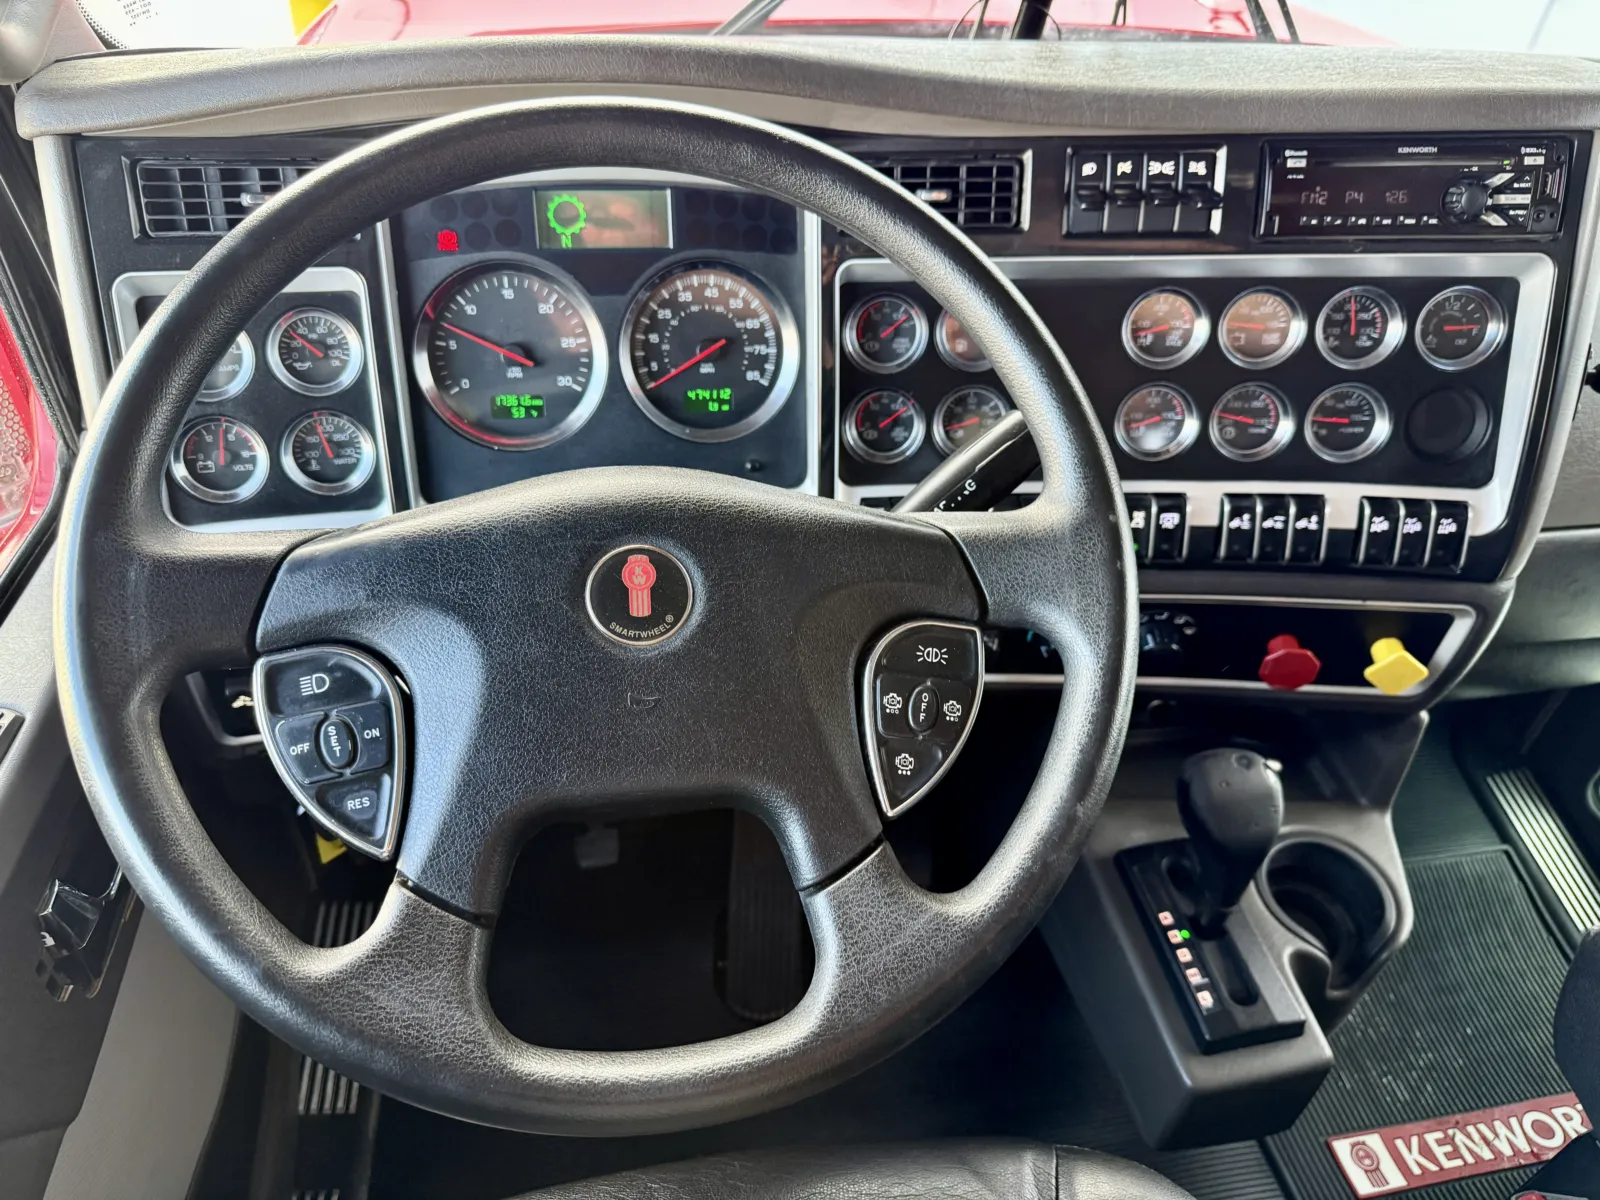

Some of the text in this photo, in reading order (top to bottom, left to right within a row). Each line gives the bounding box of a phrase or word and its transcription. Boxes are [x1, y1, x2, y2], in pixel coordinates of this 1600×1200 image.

[1397, 146, 1438, 154] KENWORTH
[561, 235, 572, 248] N
[501, 288, 514, 299] 15
[677, 291, 692, 302] 35
[704, 287, 719, 298] 45
[729, 298, 744, 309] 55
[464, 304, 477, 315] 10
[538, 304, 554, 314] 20
[657, 309, 672, 319] 25
[745, 318, 760, 329] 65
[297, 327, 309, 335] 40
[316, 326, 328, 334] 60
[326, 337, 338, 345] 80
[560, 338, 576, 348] 25
[648, 333, 659, 343] 15
[290, 340, 302, 348] 20
[449, 340, 458, 350] 5
[328, 348, 343, 357] 100
[753, 344, 767, 355] 75
[291, 352, 299, 360] 0
[218, 363, 240, 372] AMPS
[650, 361, 658, 371] 5
[745, 370, 761, 381] 85
[461, 378, 470, 389] 0
[556, 376, 573, 387] 30
[205, 434, 213, 443] 12
[333, 457, 358, 466] WATER
[232, 463, 254, 471] VOLTS
[634, 565, 644, 575] K
[631, 575, 647, 585] W
[919, 692, 929, 723] OFF
[363, 727, 381, 740] ON
[327, 725, 342, 757] SET
[289, 742, 311, 756] OFF
[346, 796, 371, 811] RES
[1392, 1103, 1592, 1176] KENWOR
